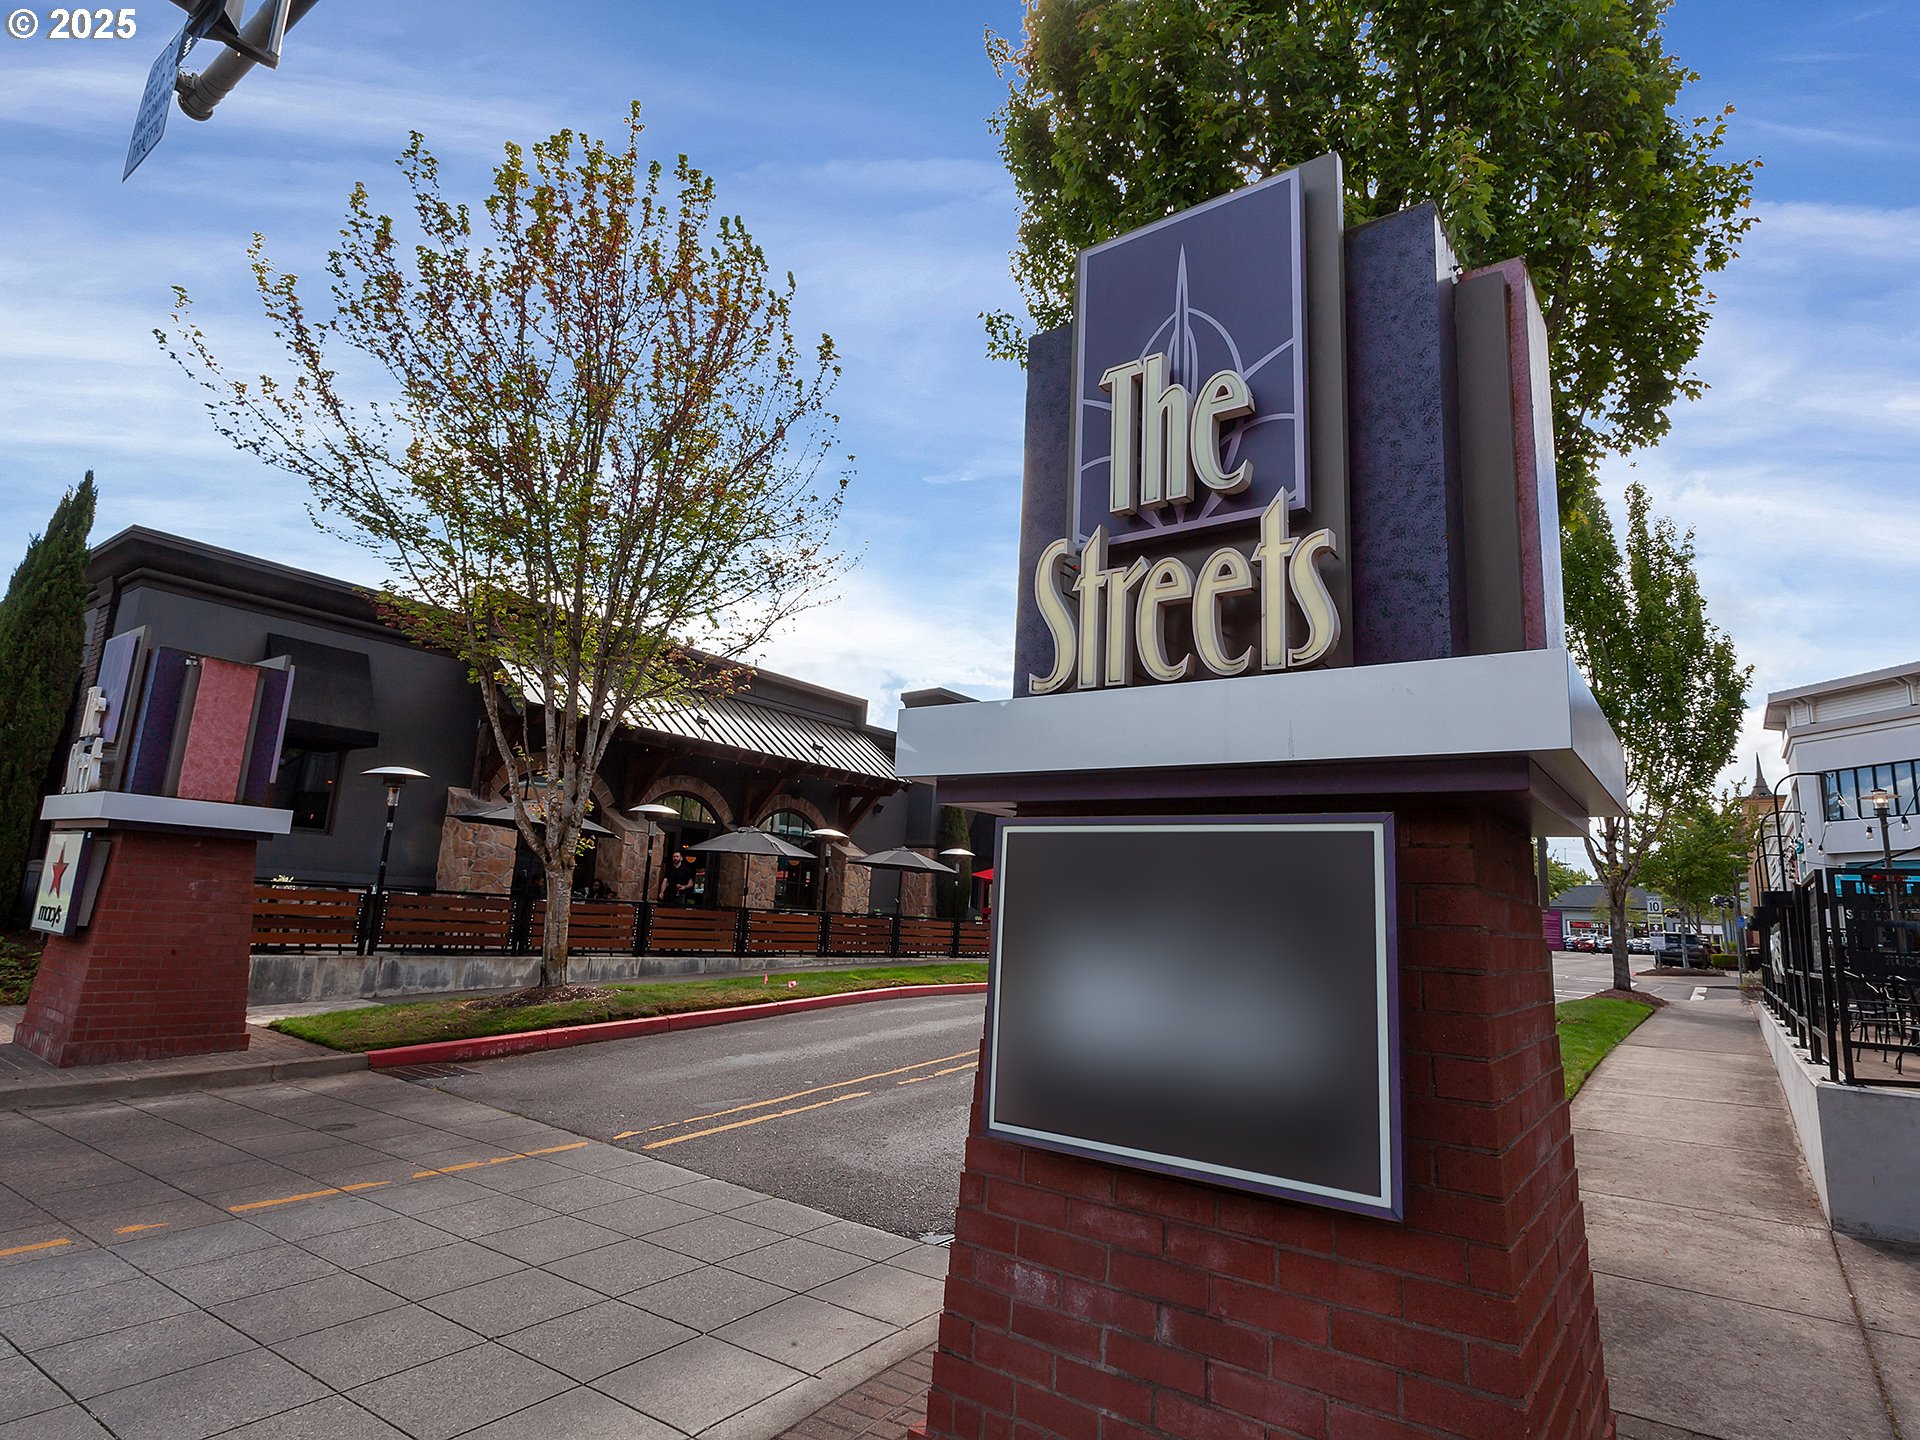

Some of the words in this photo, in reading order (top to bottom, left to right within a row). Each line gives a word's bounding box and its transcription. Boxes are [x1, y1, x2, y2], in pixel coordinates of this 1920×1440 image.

[1099, 352, 1255, 517] The
[1029, 486, 1341, 694] Streets
[1649, 901, 1660, 912] 10
